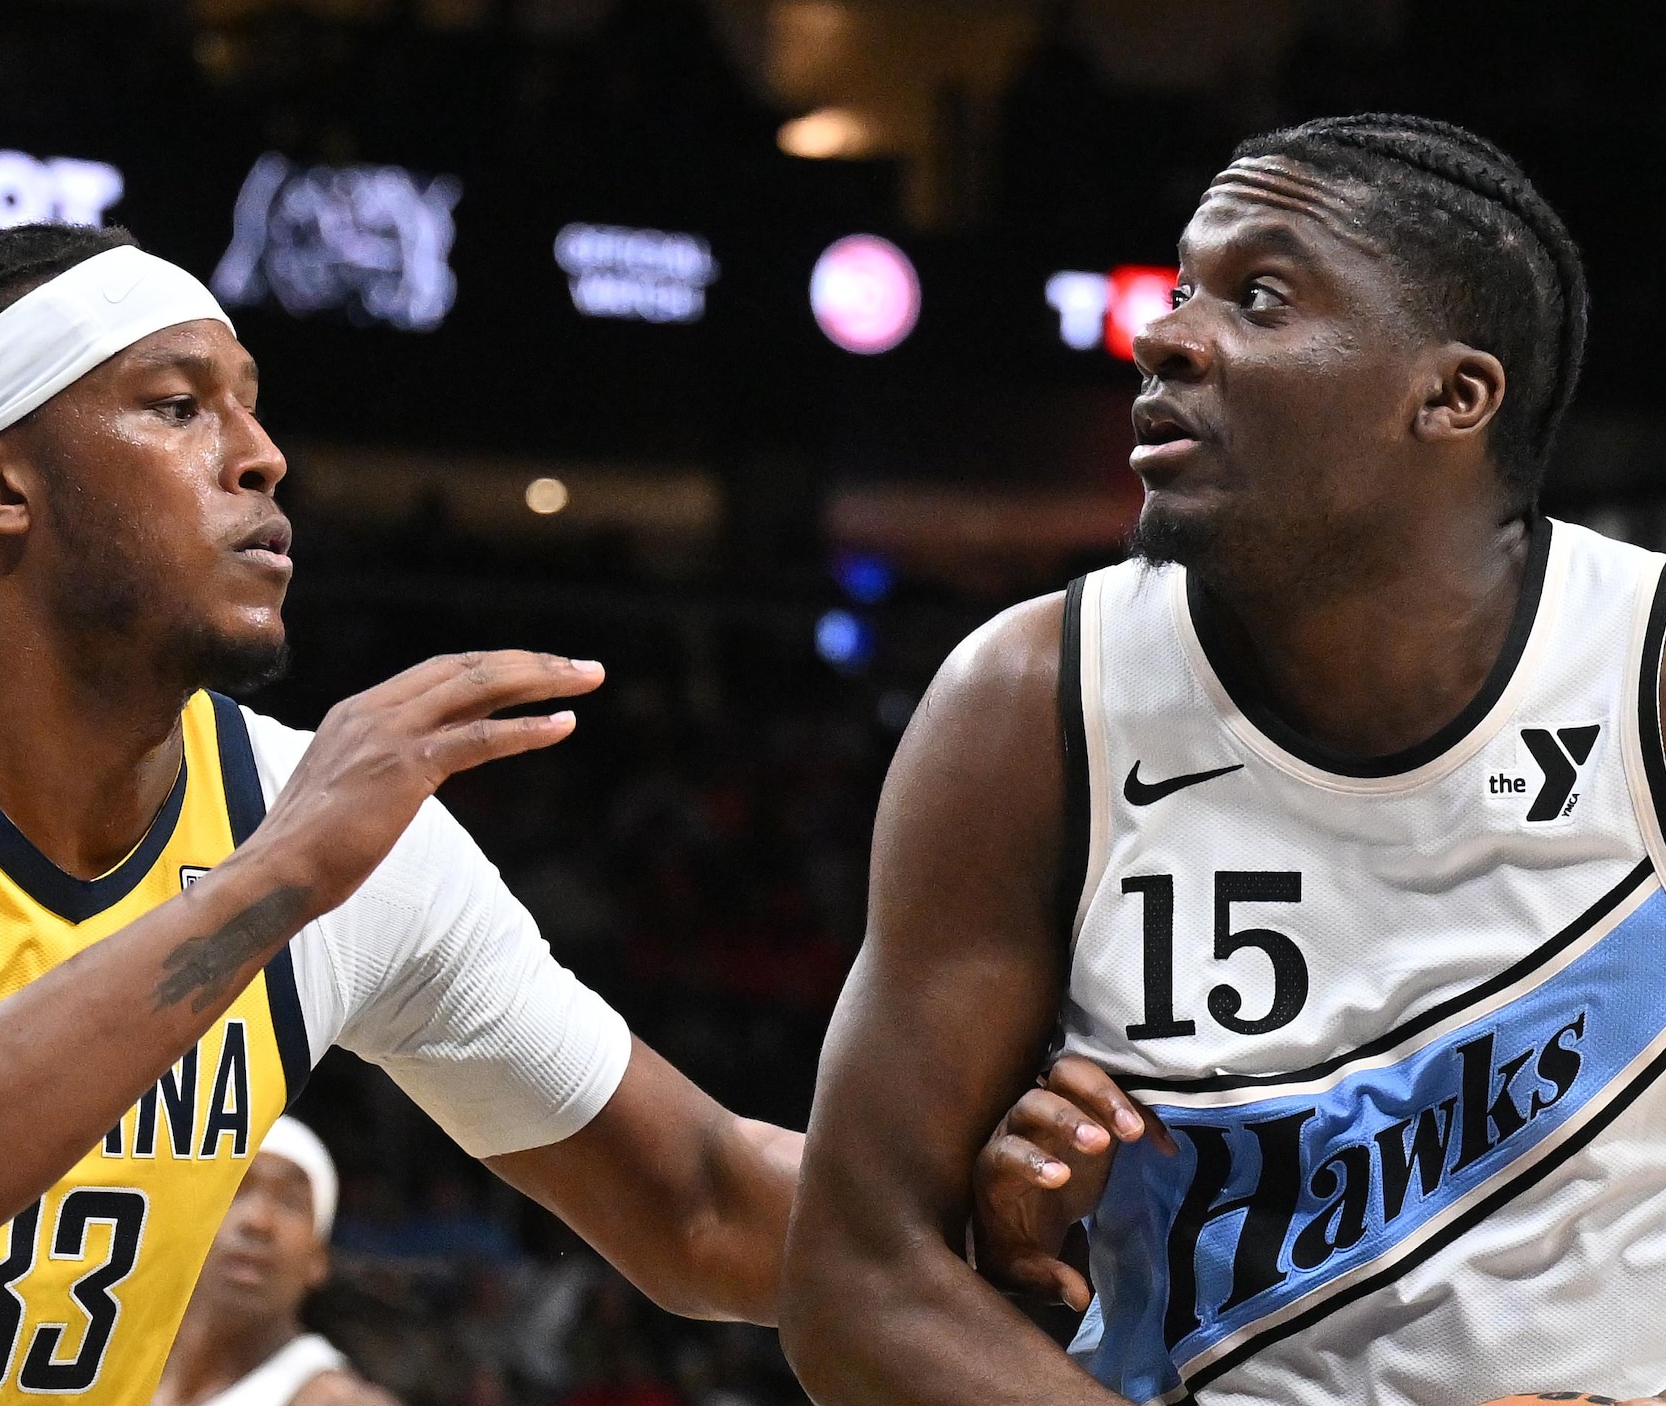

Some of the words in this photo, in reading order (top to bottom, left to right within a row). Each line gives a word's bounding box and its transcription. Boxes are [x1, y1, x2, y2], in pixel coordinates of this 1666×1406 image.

[1489, 773, 1527, 794] the
[1561, 793, 1581, 817] YMCA
[1121, 871, 1309, 1040] 15
[1163, 1012, 1585, 1348] Hawks
